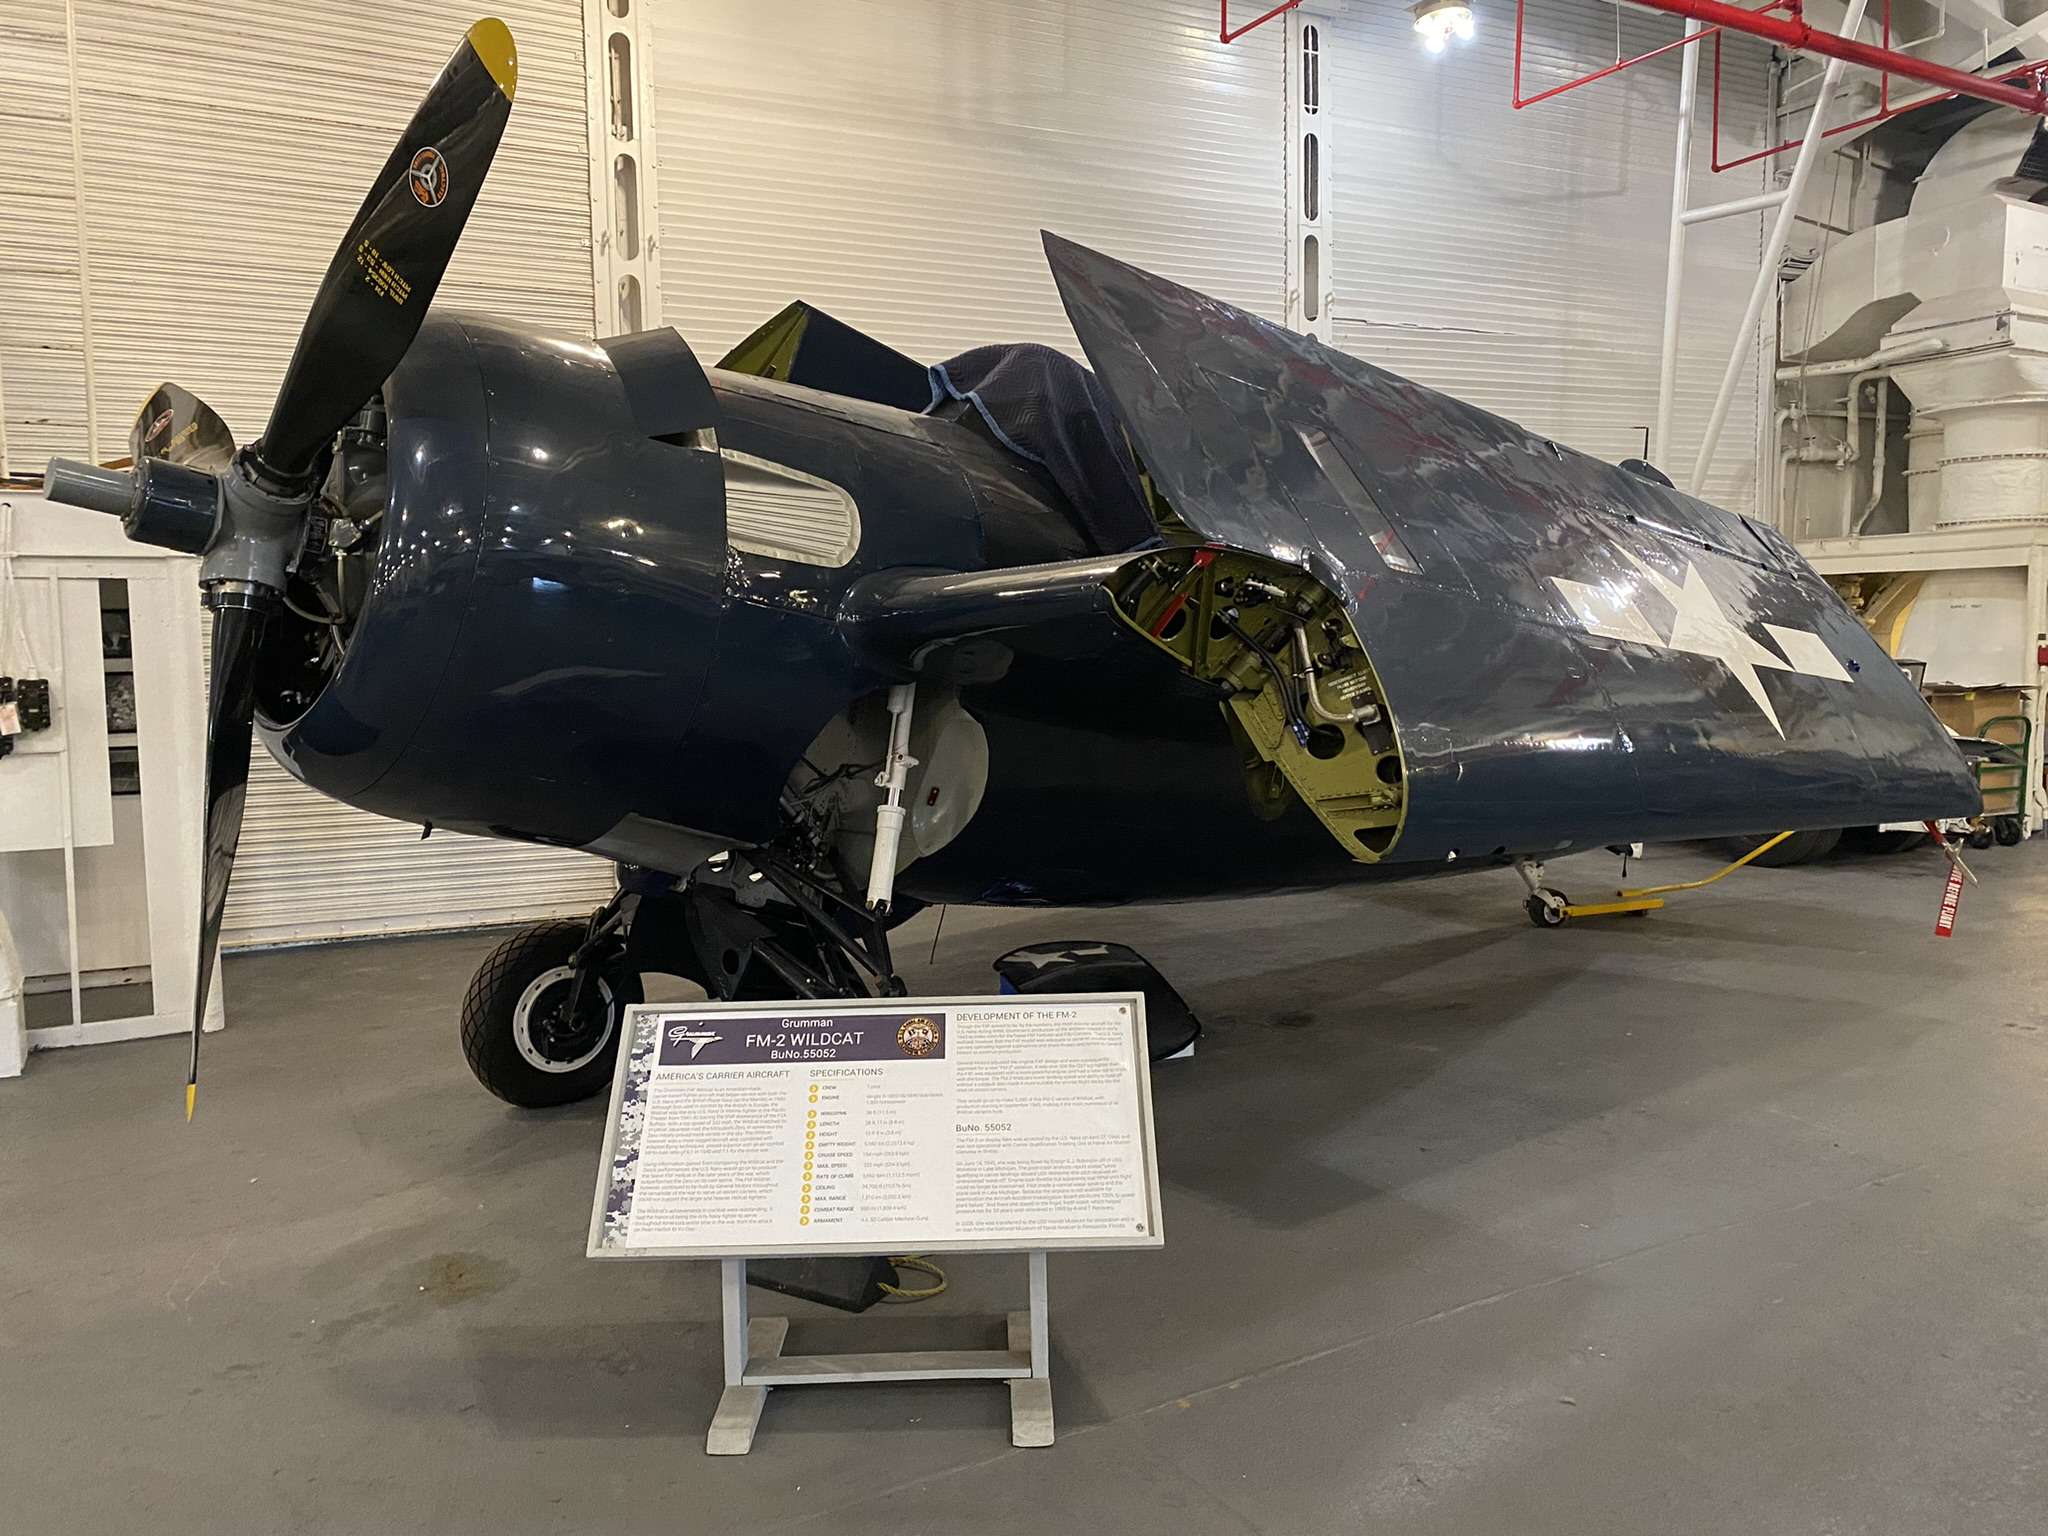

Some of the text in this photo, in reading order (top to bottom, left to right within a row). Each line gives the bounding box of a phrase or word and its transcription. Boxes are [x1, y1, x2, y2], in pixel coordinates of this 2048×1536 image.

[957, 1013, 1020, 1021] DEVELOPMENT
[1023, 1012, 1034, 1020] OF
[782, 1018, 833, 1029] Grumman
[746, 1032, 863, 1048] FM-2 WILDCAT
[771, 1049, 836, 1059] BuNo.55052
[656, 1072, 704, 1080] AMERICA'S
[810, 1069, 883, 1077] SPECIFICATIONS
[956, 1123, 1012, 1132] BuNo. 55052
